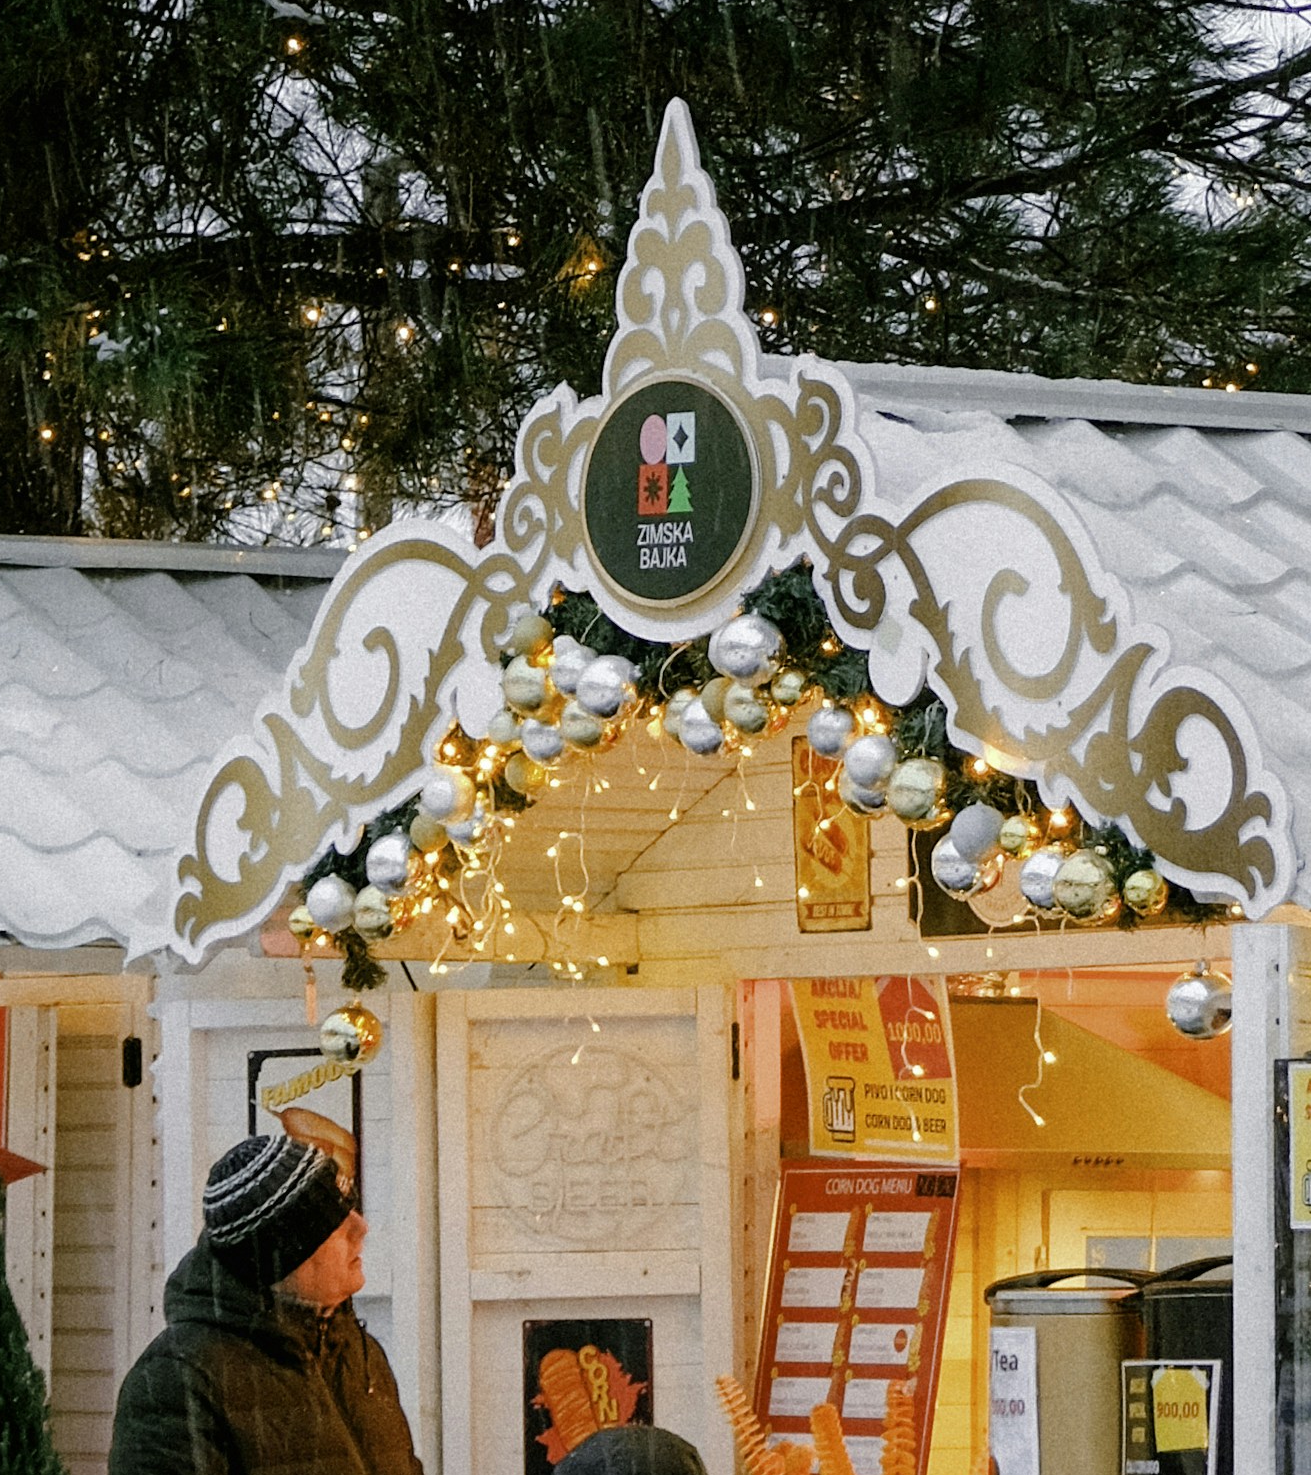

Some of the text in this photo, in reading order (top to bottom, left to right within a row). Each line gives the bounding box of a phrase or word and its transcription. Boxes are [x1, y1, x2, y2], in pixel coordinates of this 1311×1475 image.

[637, 521, 694, 546] ZIMSKA
[640, 546, 688, 569] BAJKA
[814, 1009, 869, 1031] SPECIAL
[829, 1040, 870, 1063] OFFER
[864, 1083, 888, 1101] PIVO
[925, 1088, 947, 1105] DOG
[865, 1113, 891, 1130] CORN
[924, 1116, 947, 1134] BEER
[825, 1178, 855, 1195] CORN
[855, 1178, 881, 1195] DOG
[881, 1179, 913, 1195] MENU
[579, 1344, 618, 1422] CORN
